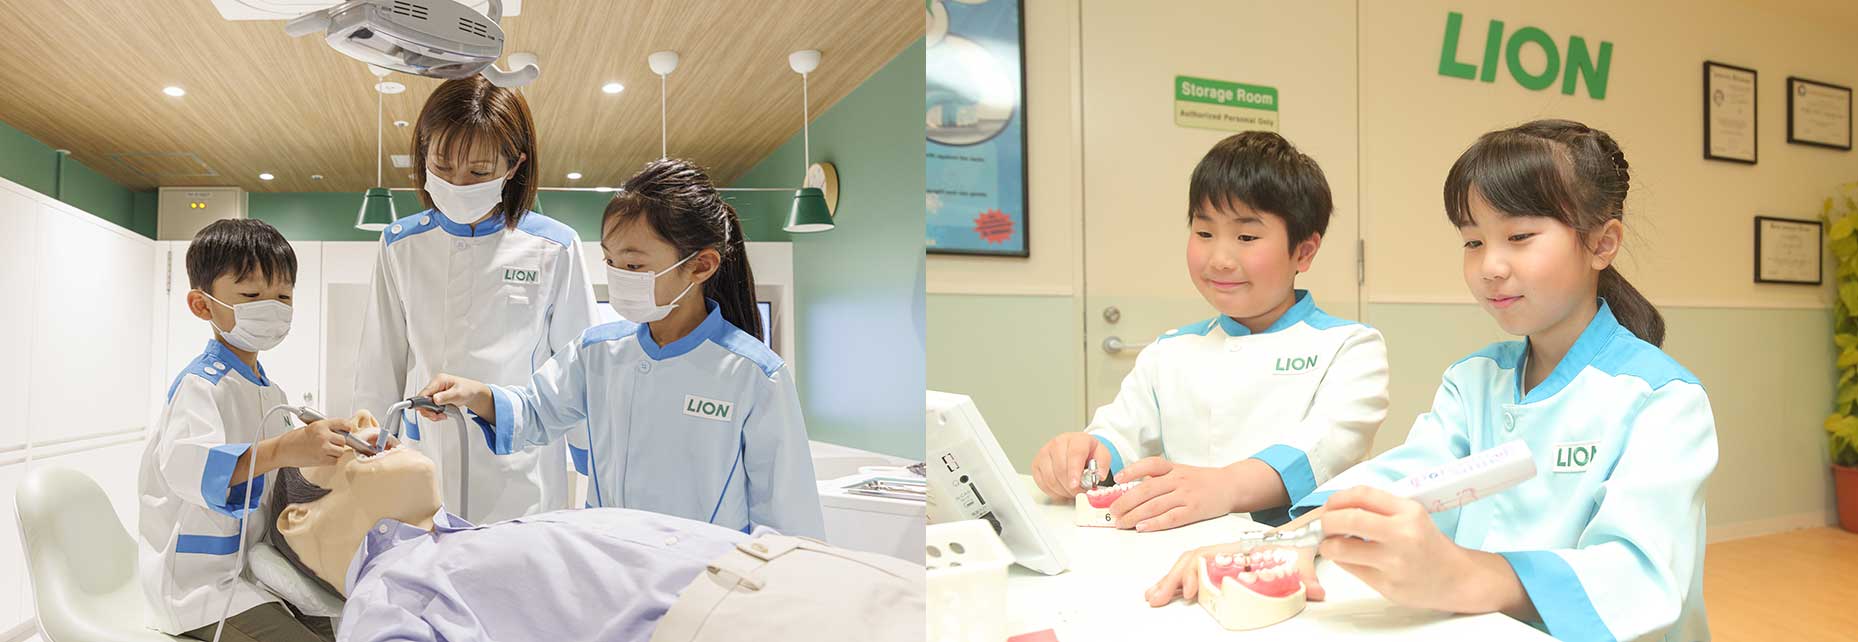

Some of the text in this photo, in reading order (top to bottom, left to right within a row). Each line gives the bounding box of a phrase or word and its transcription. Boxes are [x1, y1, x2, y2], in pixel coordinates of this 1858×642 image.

[1438, 11, 1613, 100] LION
[1182, 82, 1274, 105] Storage Room
[1258, 117, 1274, 127] Only
[504, 269, 537, 281] LION
[1275, 354, 1318, 371] LION
[687, 398, 730, 418] LION
[1105, 513, 1111, 521] 6
